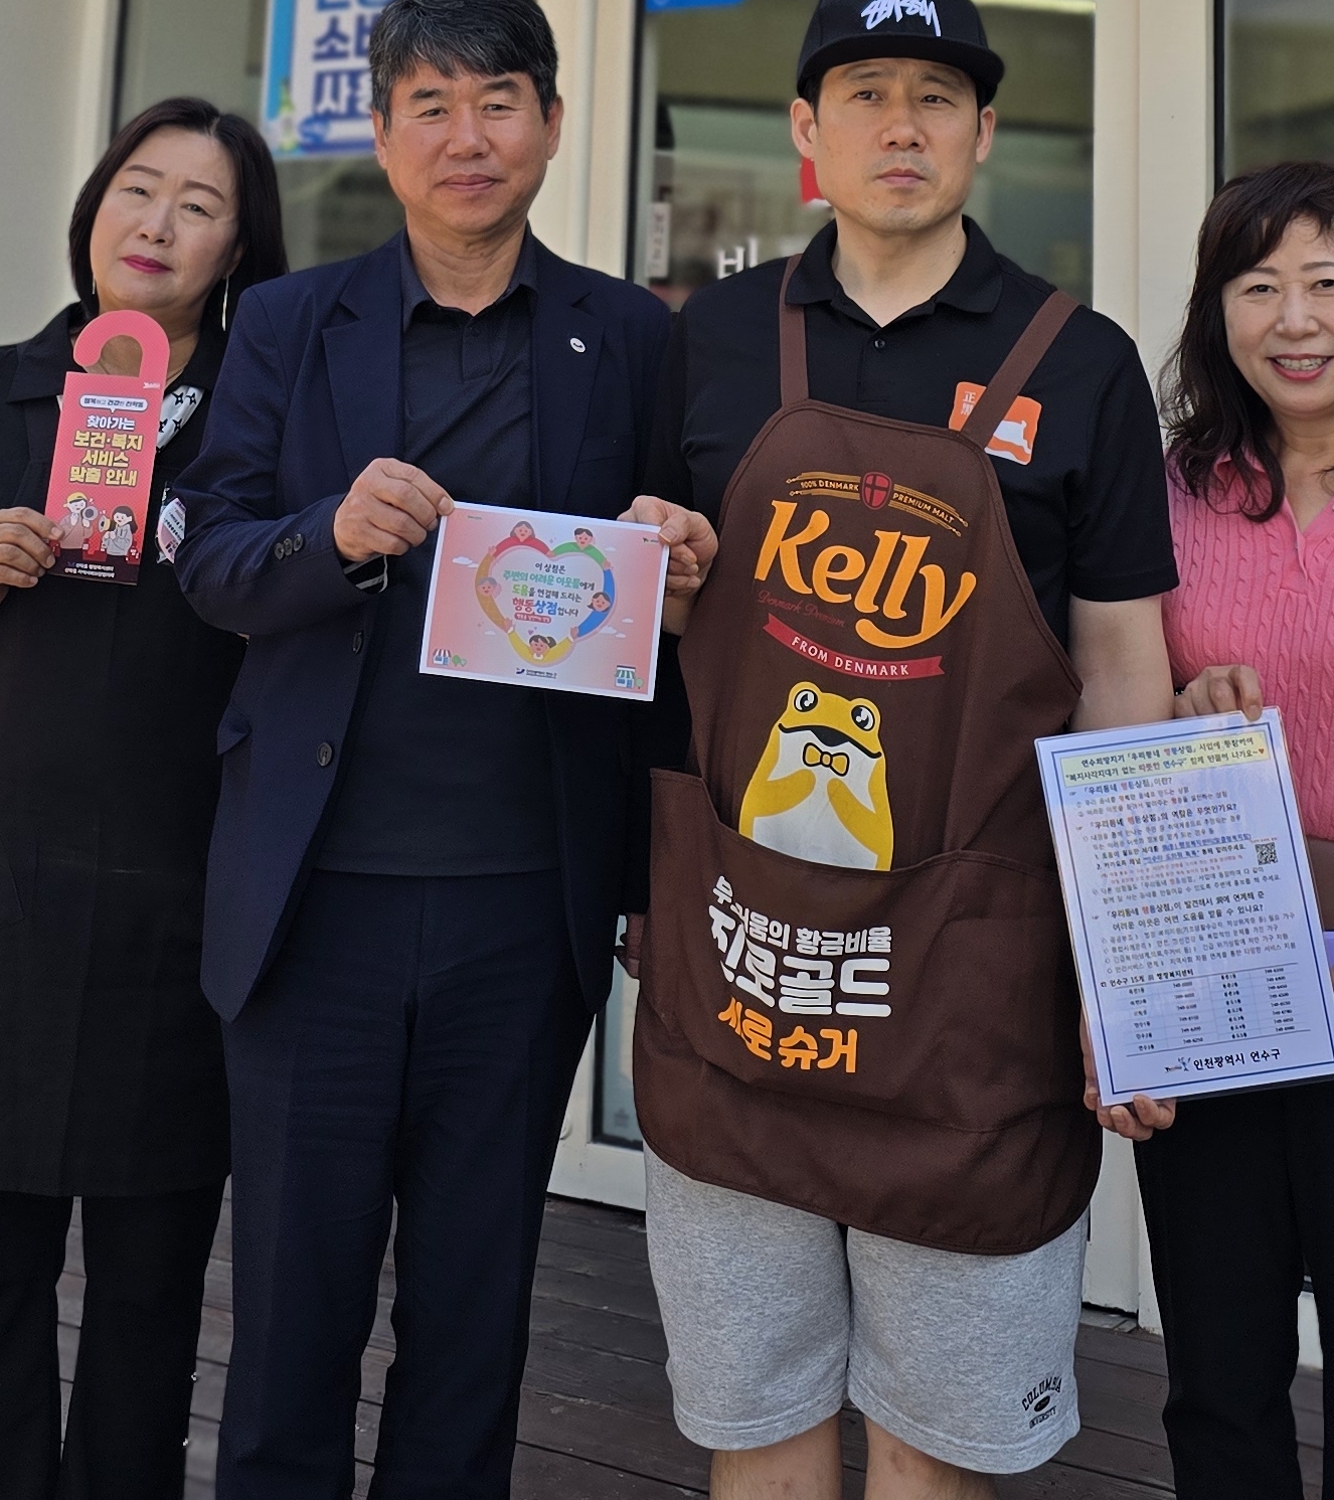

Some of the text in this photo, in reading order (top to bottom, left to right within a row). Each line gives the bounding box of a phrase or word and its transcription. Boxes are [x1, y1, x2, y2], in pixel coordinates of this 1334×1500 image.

[87, 415, 135, 430] 찾아가는
[73, 430, 144, 451] 보건·복지
[81, 449, 129, 468] 서비스
[69, 466, 138, 487] 맞춤 안내
[818, 480, 859, 491] DENMARK
[893, 492, 931, 512] PREMIUM
[932, 508, 954, 523] MALT
[754, 500, 977, 649] Kelly
[791, 636, 909, 676] FROM DENMARK
[796, 926, 892, 956] 황금비율
[778, 1025, 858, 1074] 슈거
[1192, 1048, 1281, 1071] 인천광역시 연수구
